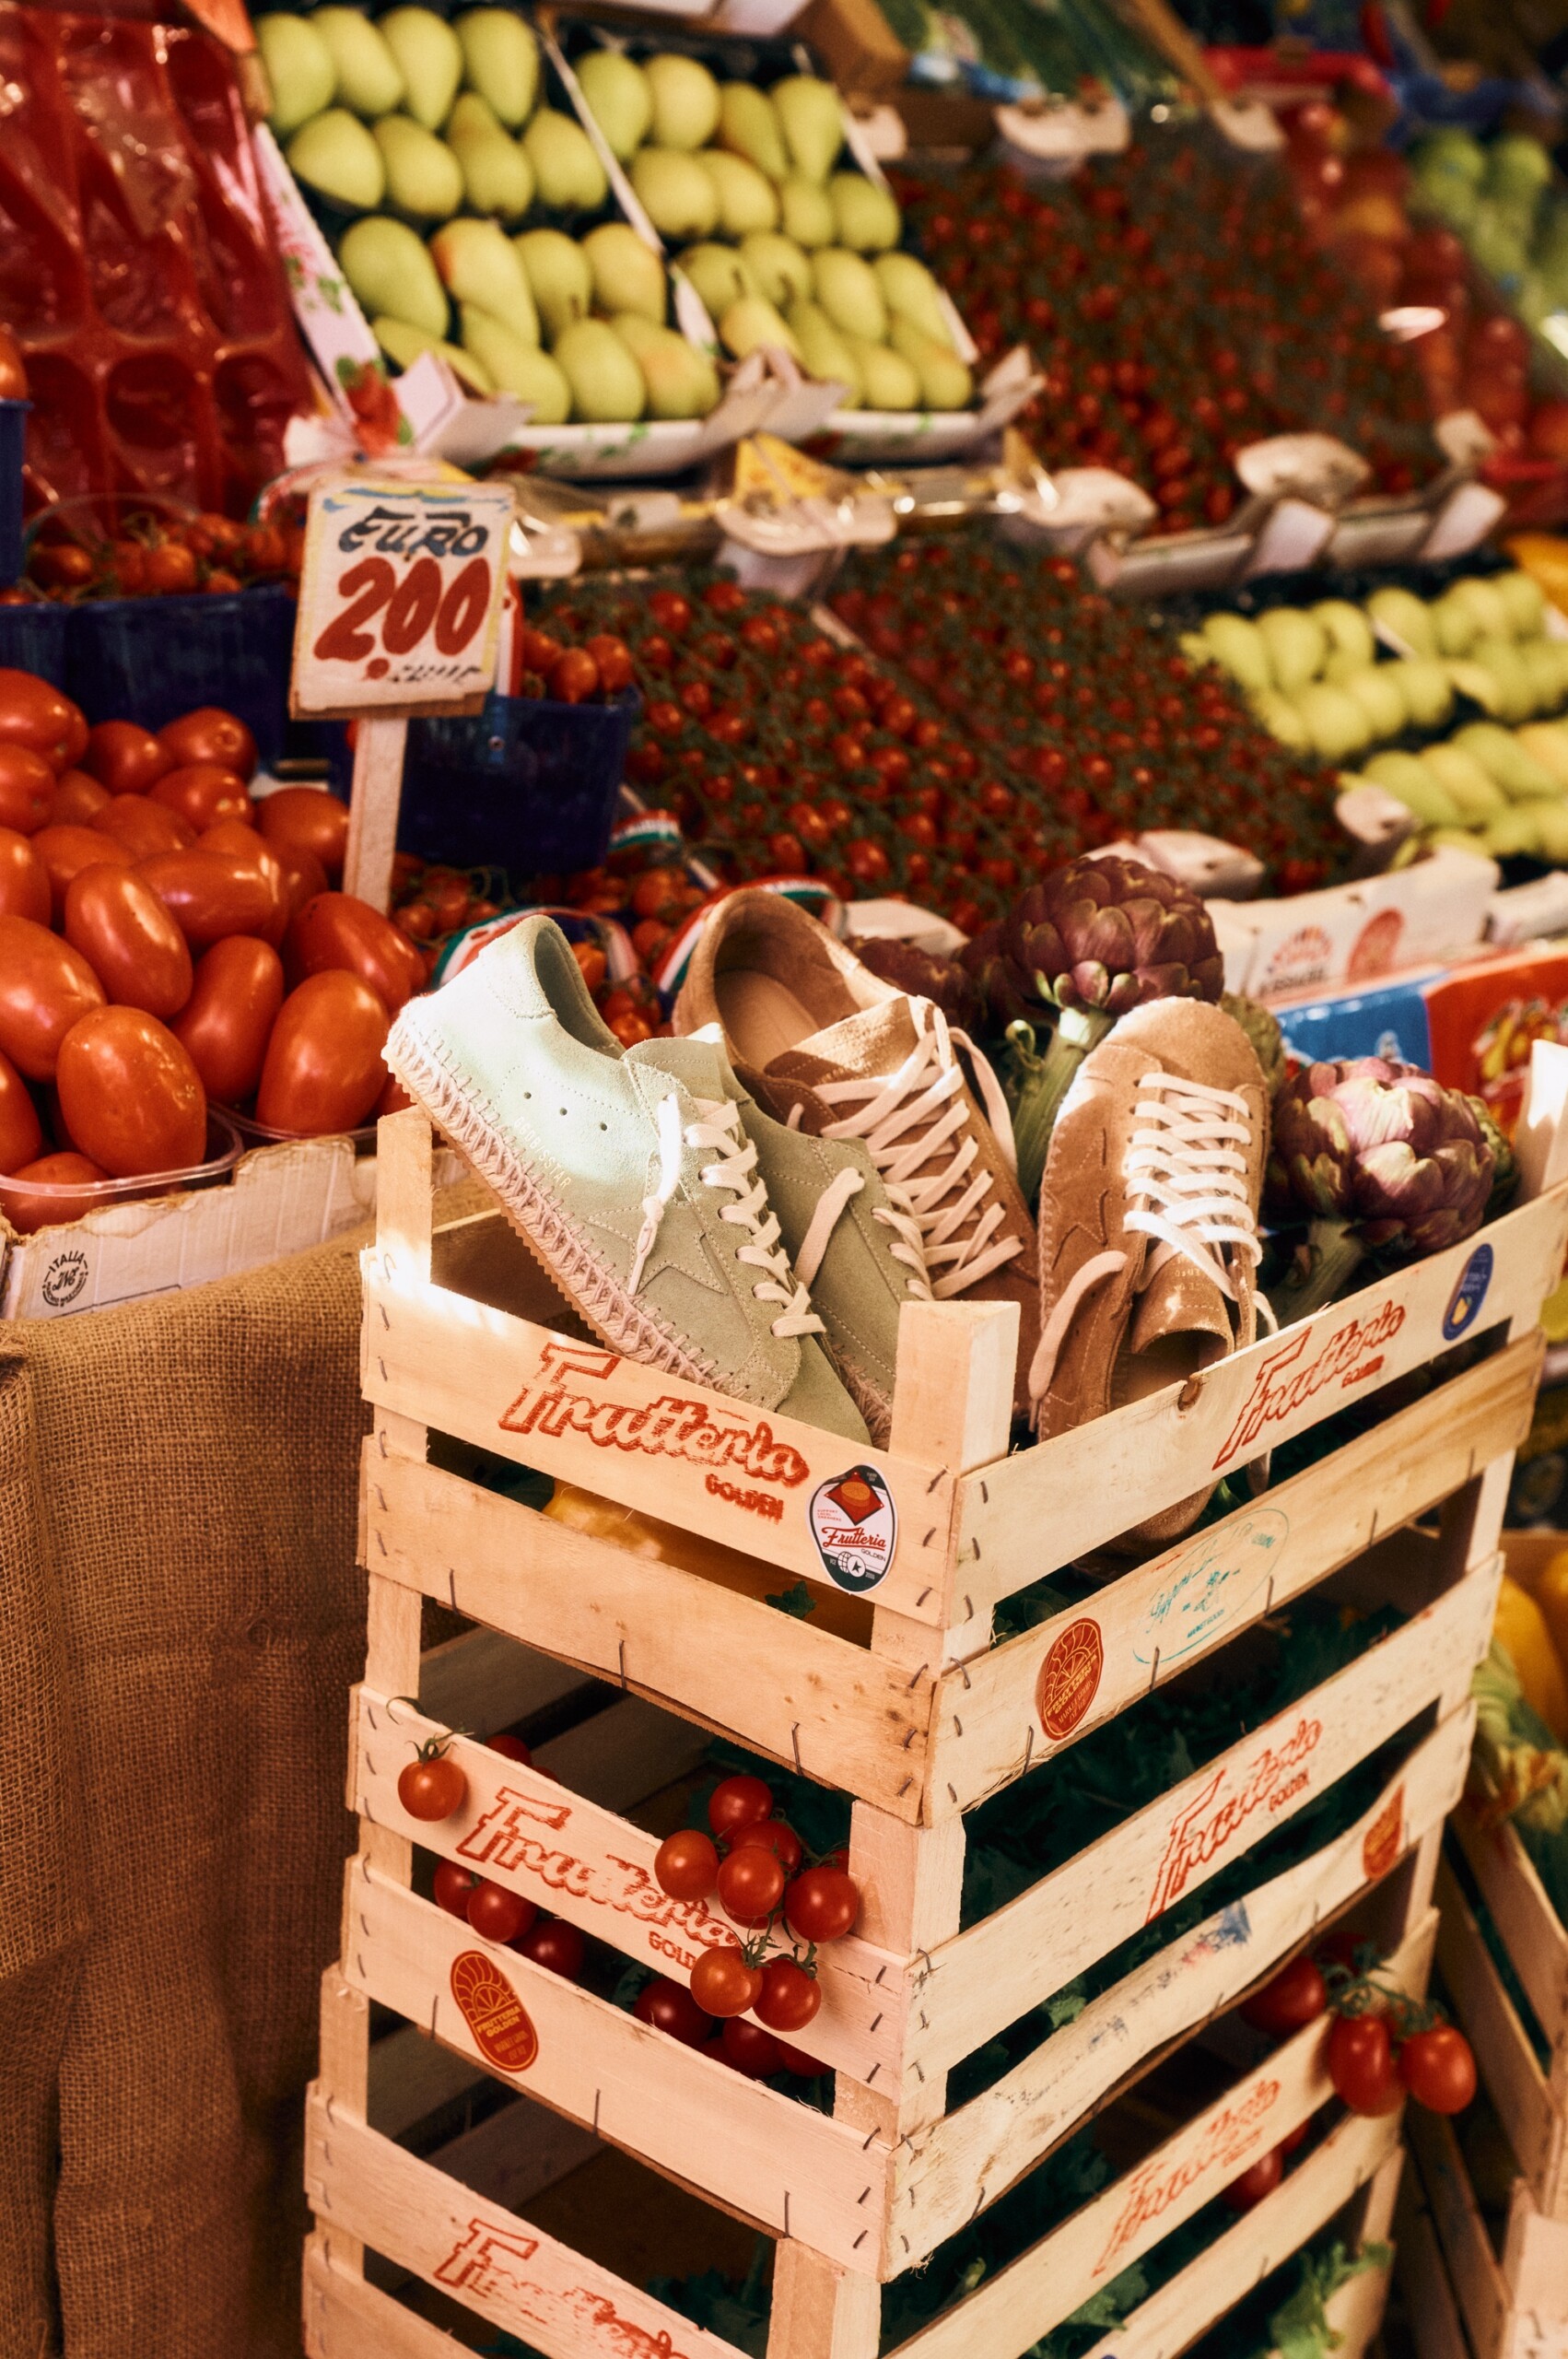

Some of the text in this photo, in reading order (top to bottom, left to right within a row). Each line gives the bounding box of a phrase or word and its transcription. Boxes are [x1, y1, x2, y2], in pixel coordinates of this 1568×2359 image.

[49, 1250, 84, 1273] ITALIA
[498, 1342, 810, 1488] Frutteria
[705, 1473, 783, 1525] GOLDEN
[821, 1526, 886, 1552] Frutteria
[860, 1548, 886, 1562] GOLDEN
[1047, 1653, 1097, 1717] FRUTTERIA
[1054, 1664, 1092, 1714] GOLDEN
[648, 1931, 697, 1970] GOLD
[476, 2005, 522, 2034] FRUTTERIA
[486, 2015, 521, 2037] GOLDEN
